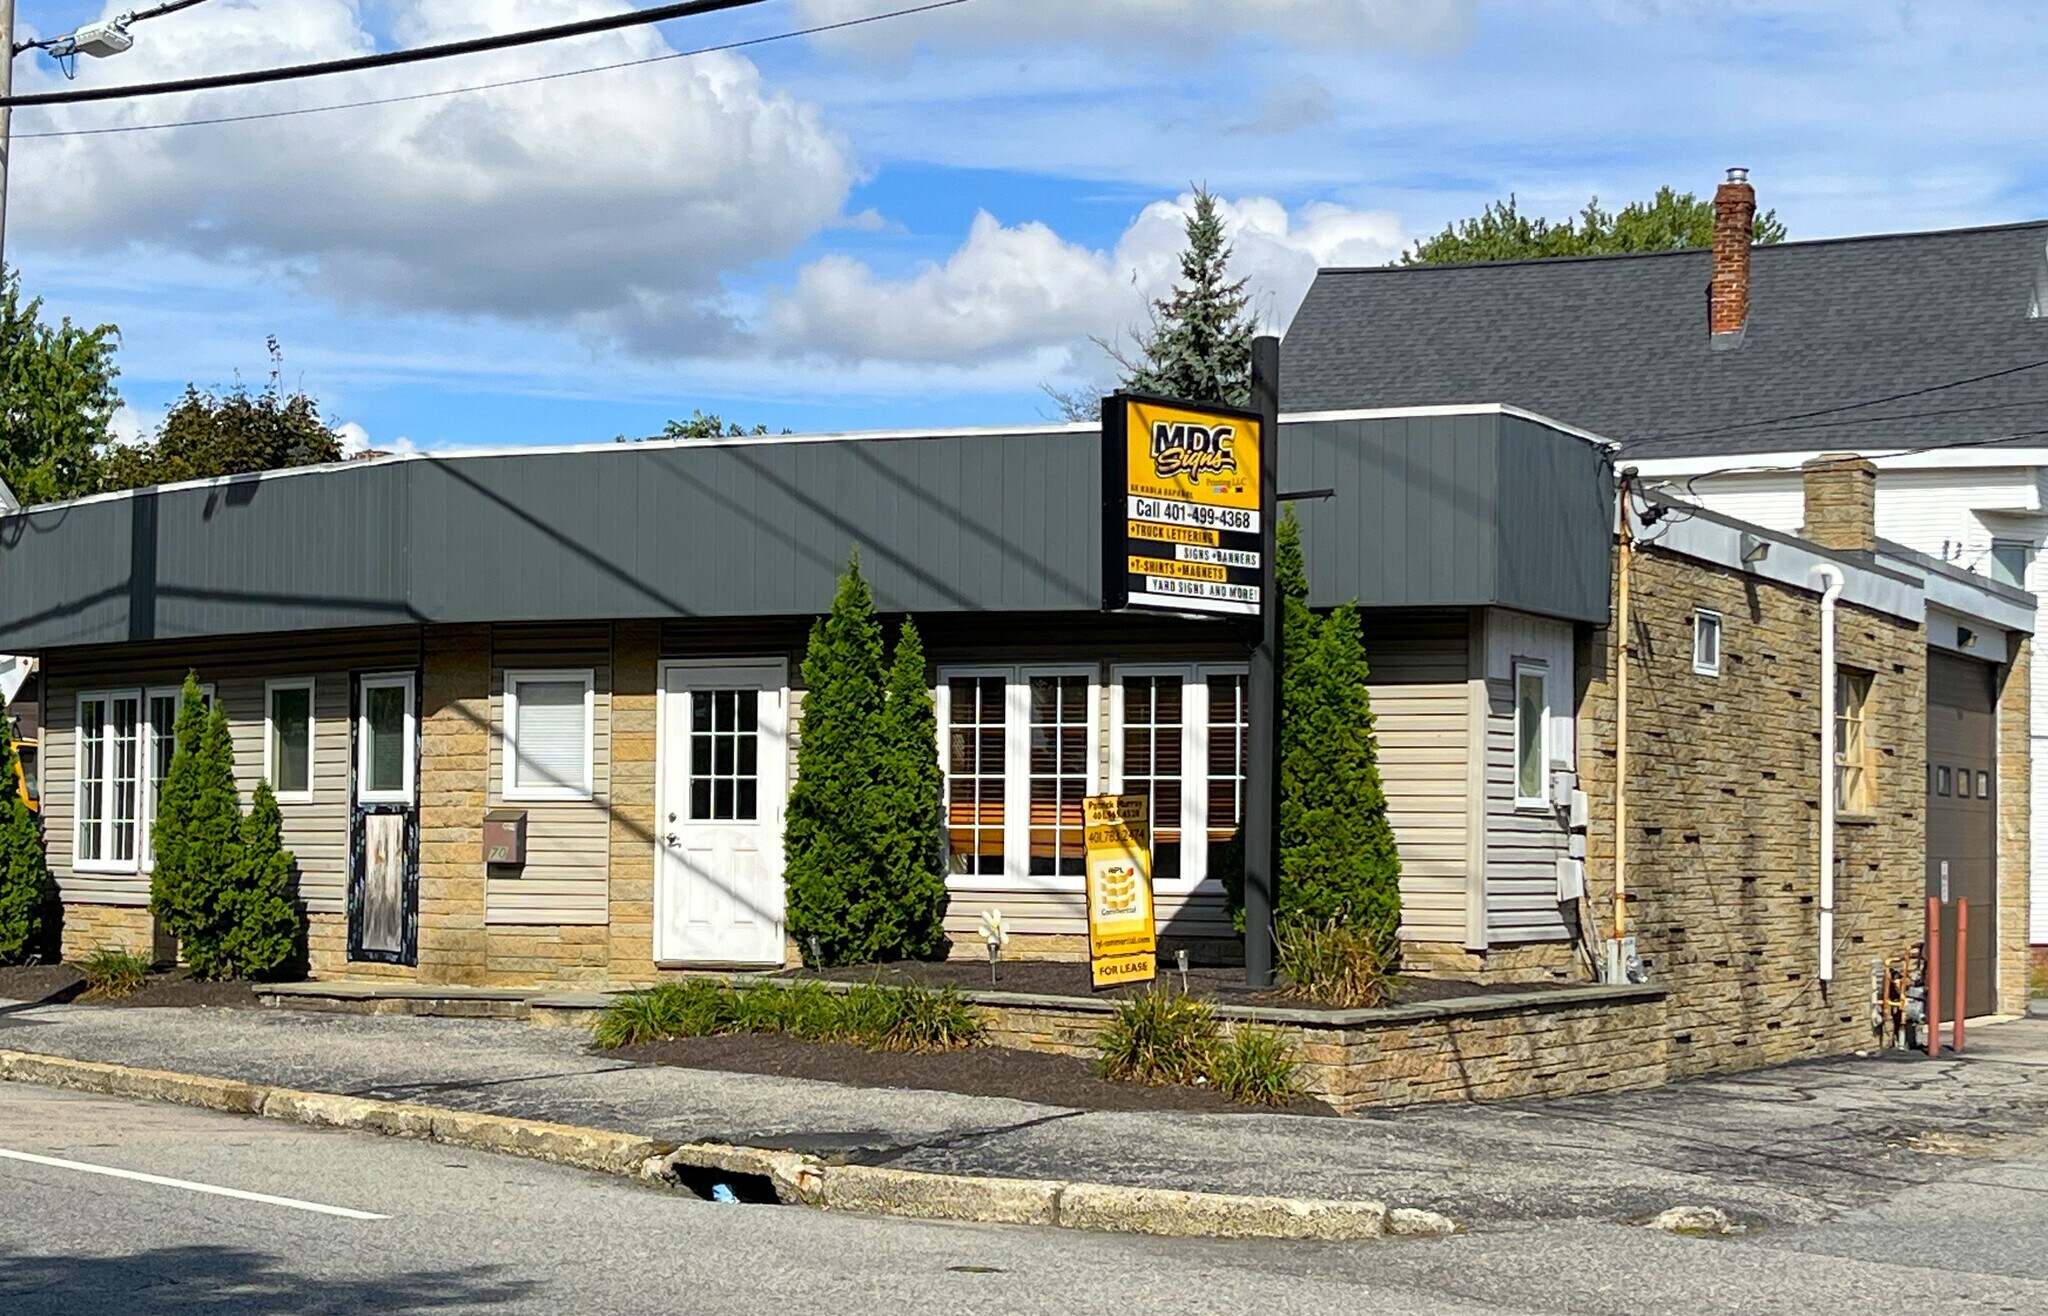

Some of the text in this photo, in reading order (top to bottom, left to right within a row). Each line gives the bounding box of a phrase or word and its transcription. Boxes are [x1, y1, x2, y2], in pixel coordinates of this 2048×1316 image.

[1152, 421, 1236, 458] MDC
[1156, 446, 1236, 485] Signs
[1232, 478, 1247, 486] LLC
[1136, 499, 1250, 529] Call 401-499-4368
[1135, 524, 1213, 544] TRUCK LETTERING
[1184, 547, 1256, 565] SIGNS BANNERS
[1182, 564, 1224, 580] MAGNETS
[1152, 579, 1175, 592] YARD
[1178, 581, 1205, 596] SIGNS
[1209, 586, 1227, 598] AND
[490, 847, 506, 858] 70
[1099, 962, 1148, 977] FOR LEASE
